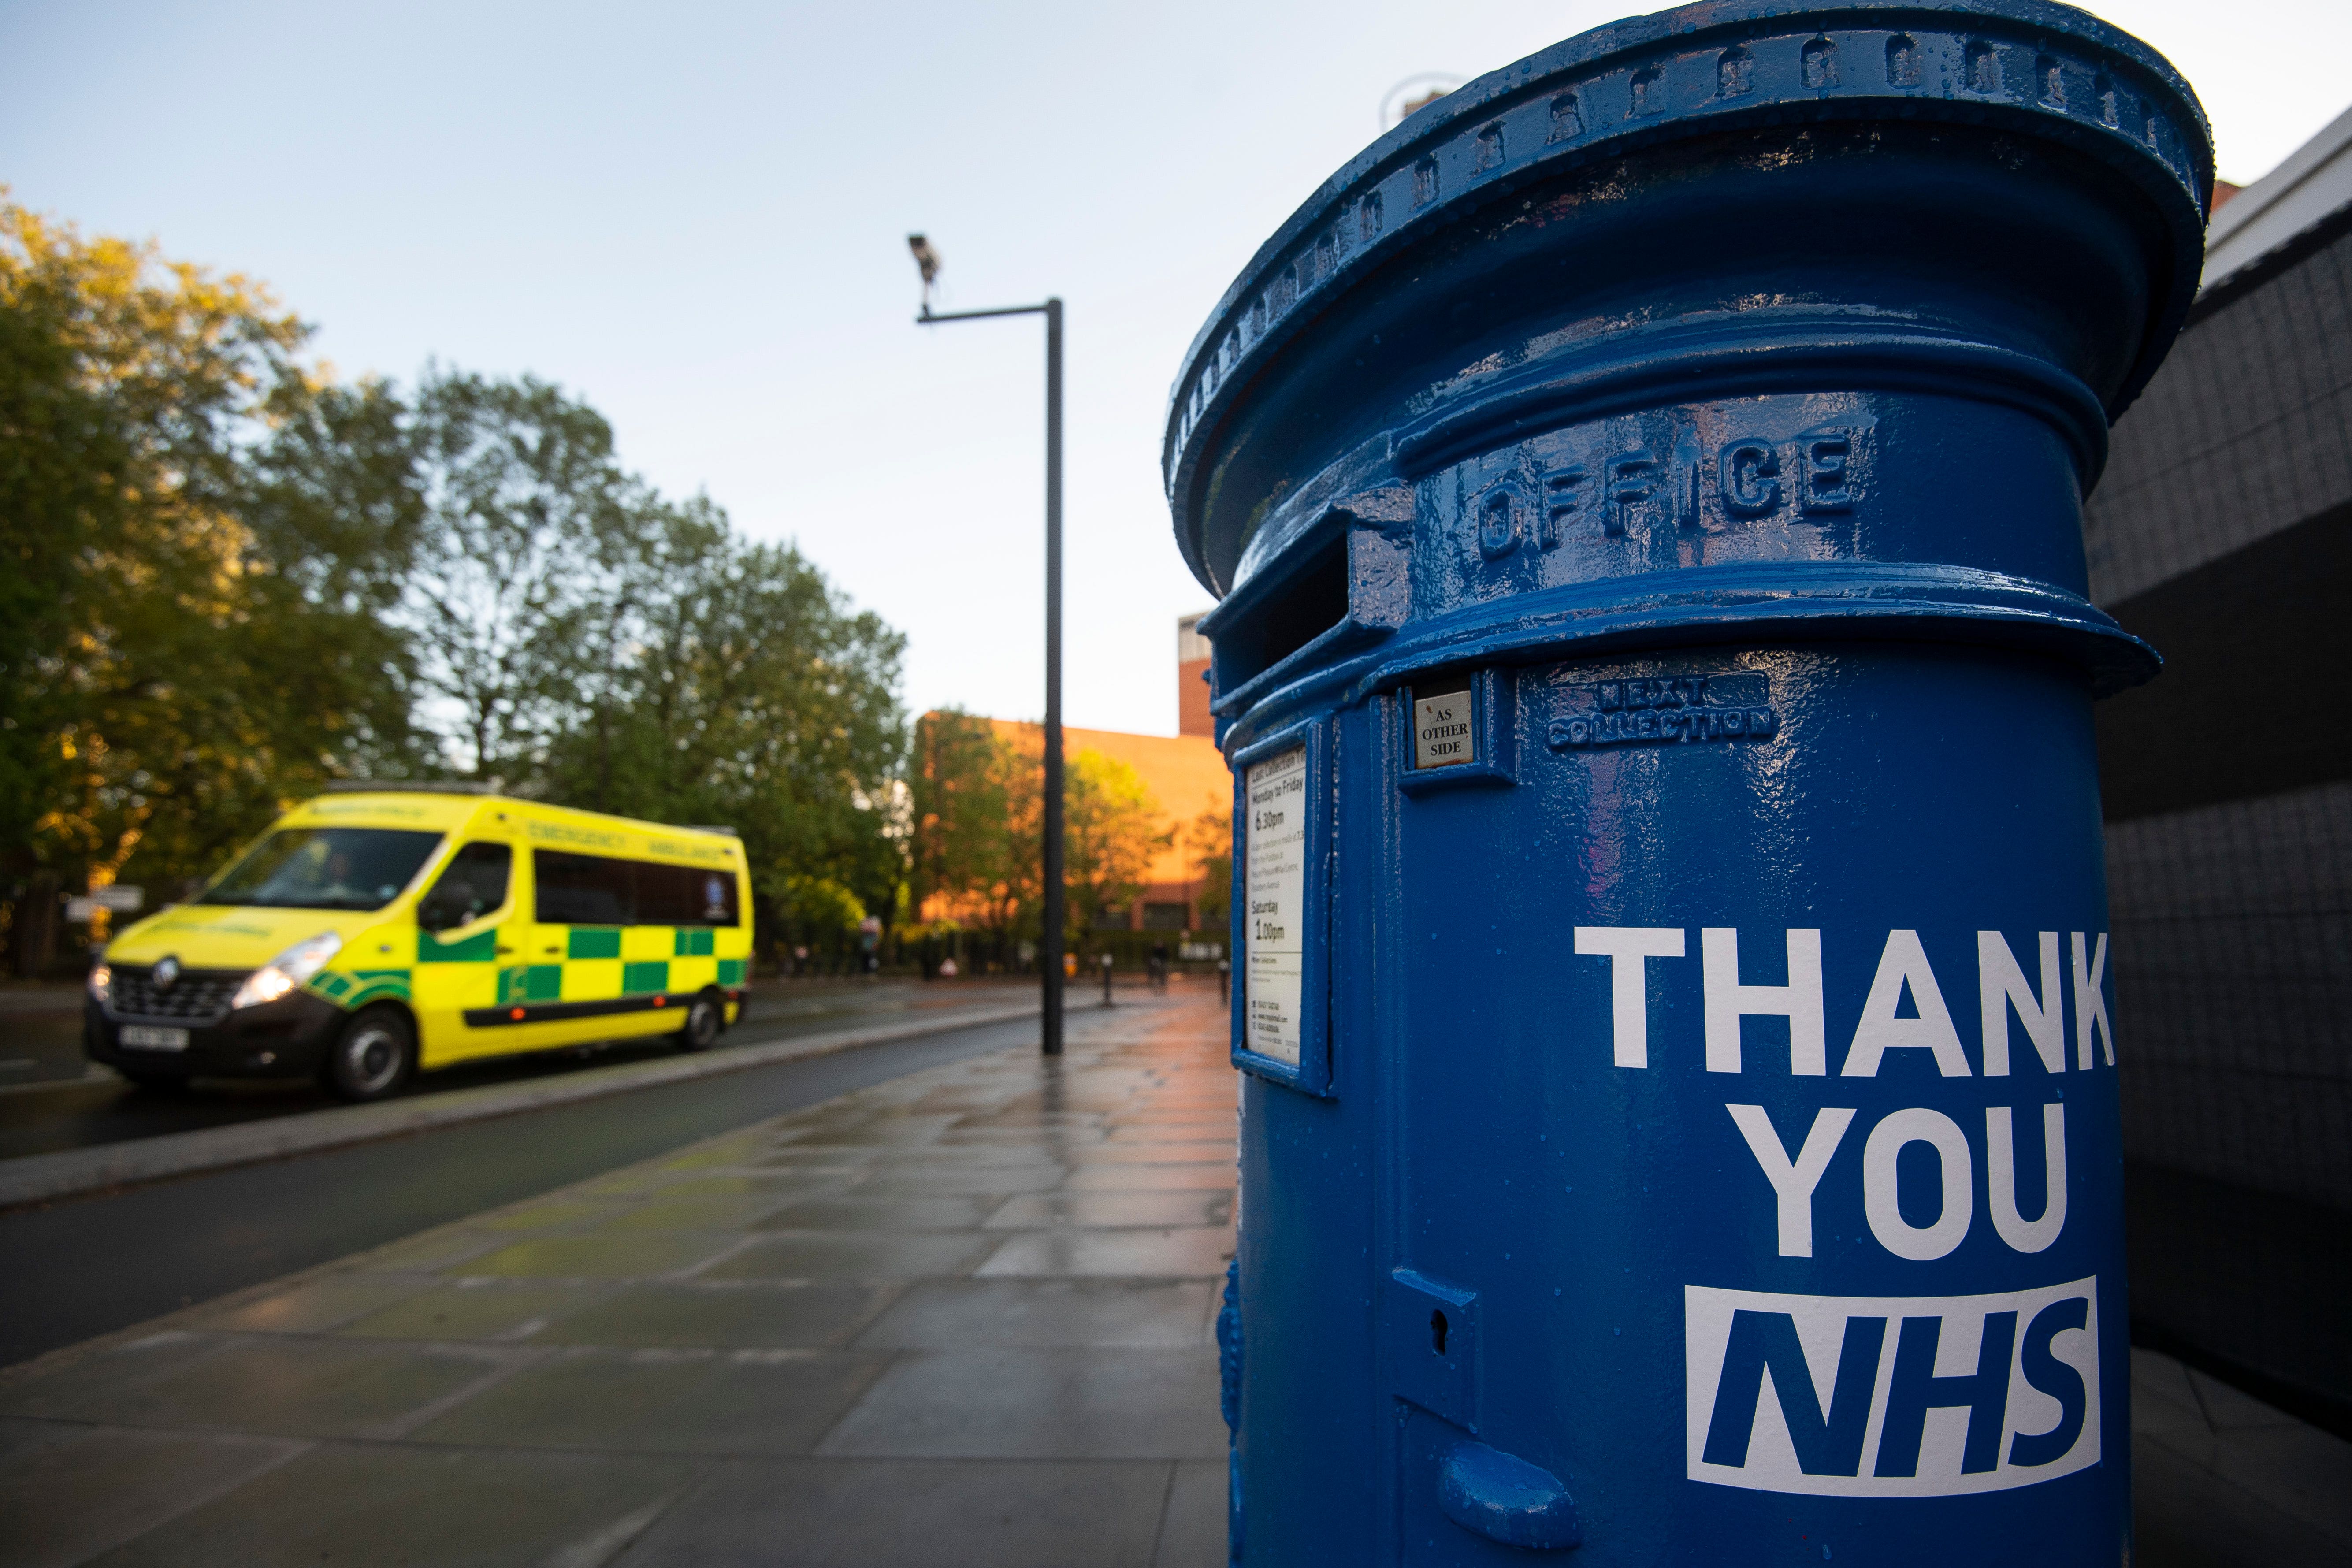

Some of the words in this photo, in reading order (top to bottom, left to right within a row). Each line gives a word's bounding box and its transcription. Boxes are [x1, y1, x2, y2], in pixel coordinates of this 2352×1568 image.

[1477, 432, 1856, 562] OFFICE
[1596, 677, 1705, 710] NEXT
[1436, 708, 1452, 722] AS
[1422, 723, 1468, 740] OTHER
[1548, 706, 1773, 751] COLLECTION
[1431, 741, 1461, 756] SIDE
[1275, 785, 1282, 797] to
[1283, 777, 1304, 794] Friday
[1256, 809, 1284, 831] 6.30pm
[1252, 899, 1278, 916] Saturday
[1256, 918, 1285, 943] 1.00pm
[1575, 926, 2115, 1077] THANK
[1724, 1103, 2067, 1261] YOU
[1702, 1297, 2089, 1478] NHS
